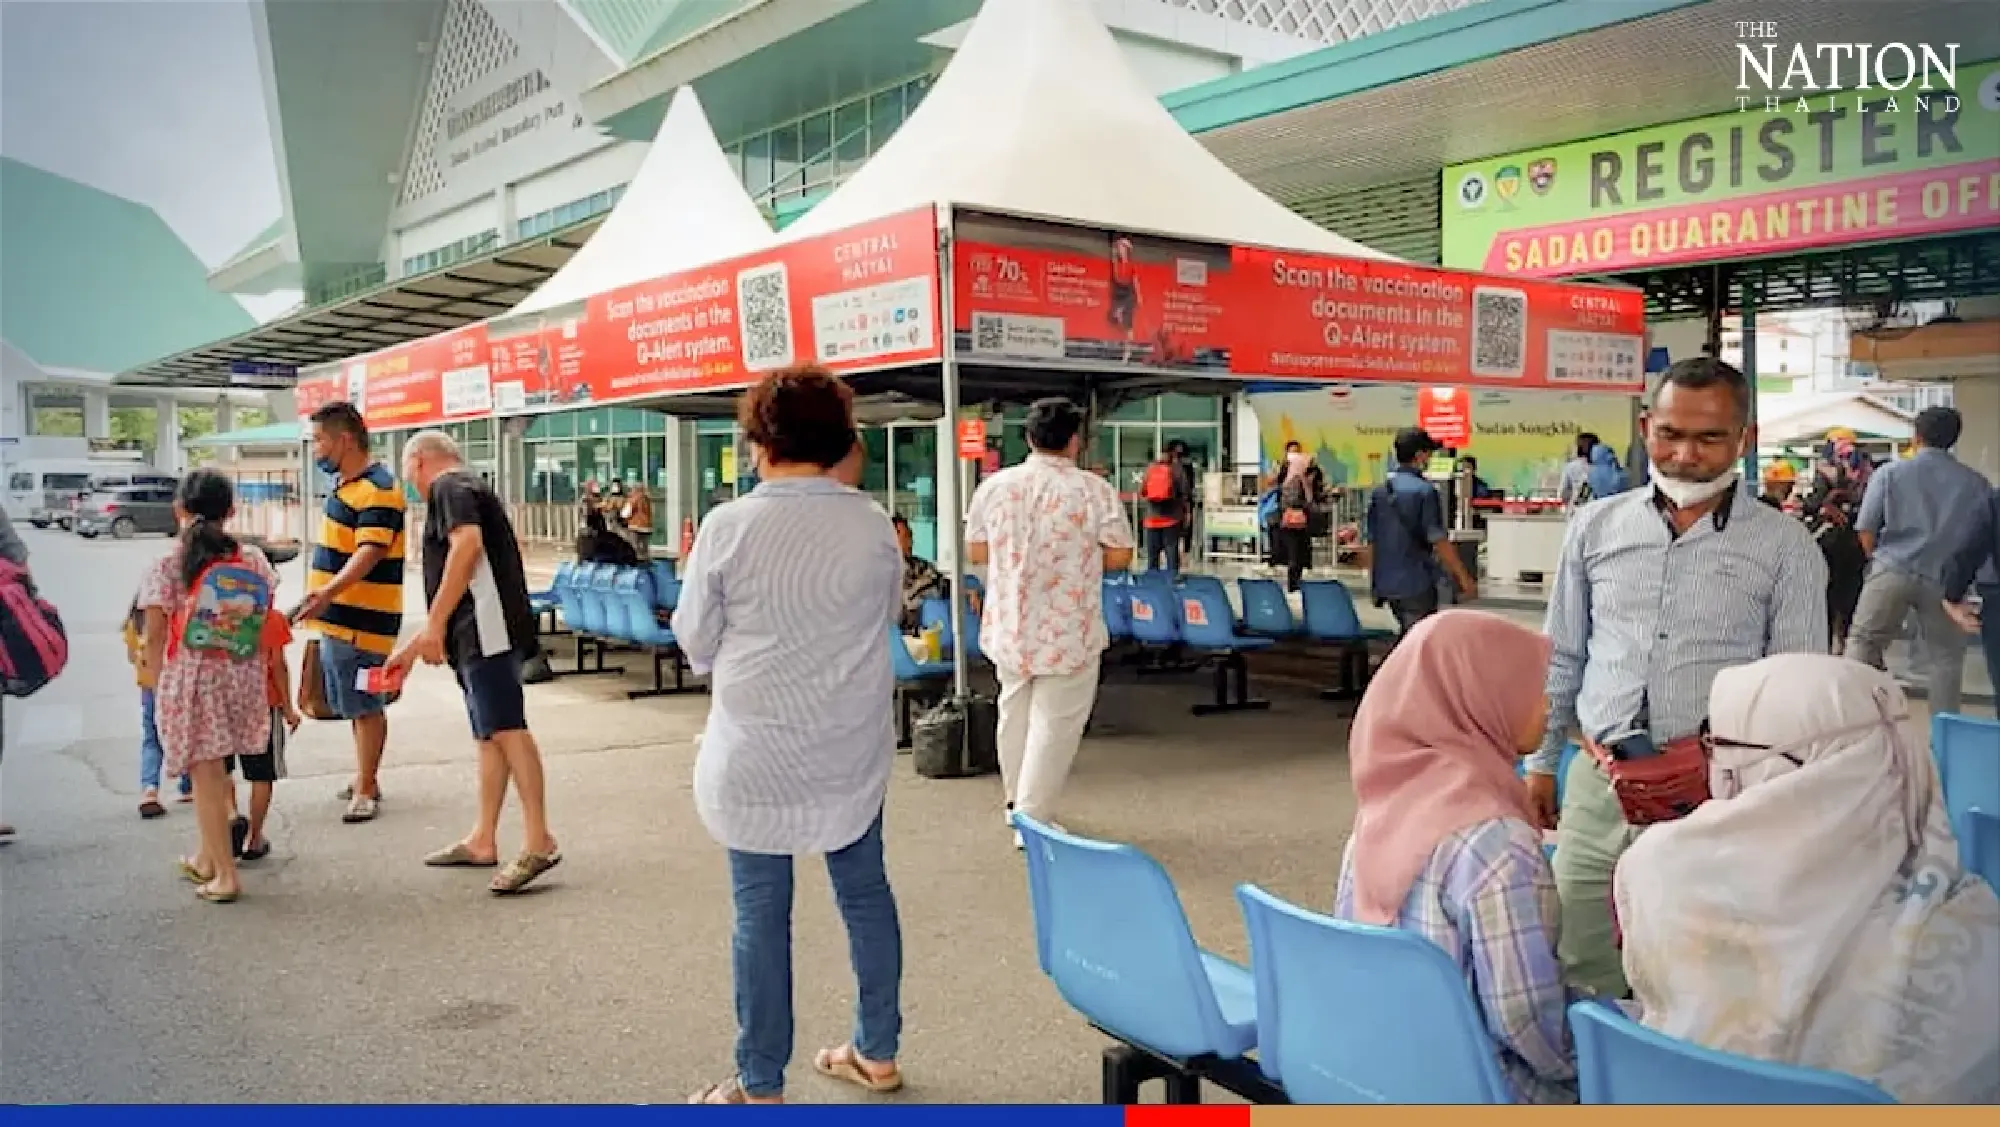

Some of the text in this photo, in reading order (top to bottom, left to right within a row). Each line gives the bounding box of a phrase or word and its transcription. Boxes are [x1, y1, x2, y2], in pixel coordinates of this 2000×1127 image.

[1590, 90, 1963, 208] REGISTER
[834, 233, 898, 262] CENTRAL
[1505, 227, 1613, 273] SADAO
[1629, 188, 1898, 258] QUARANTINE
[1272, 258, 1464, 303] Scan the vaccination
[1311, 293, 1464, 329] documents in the
[1323, 322, 1461, 357] Q-Alert system.
